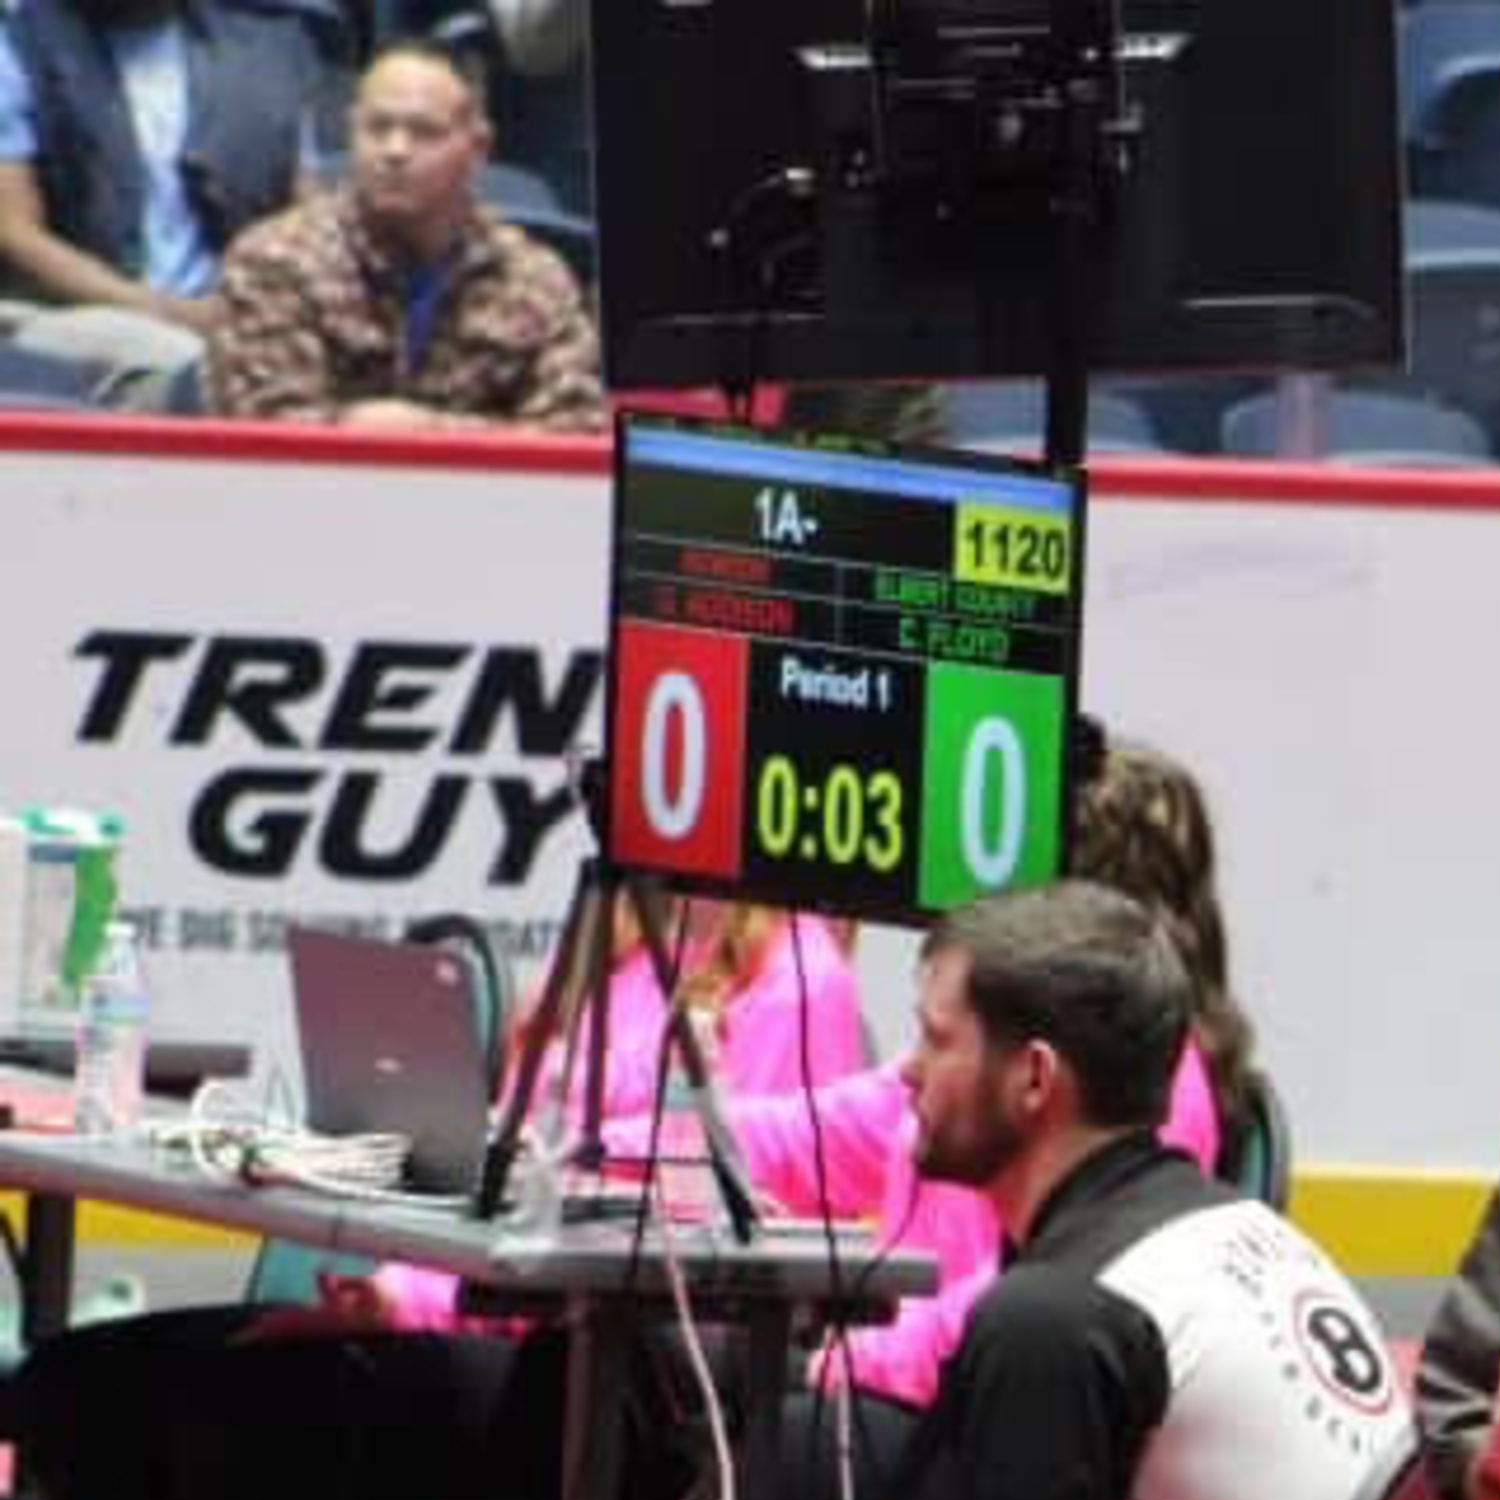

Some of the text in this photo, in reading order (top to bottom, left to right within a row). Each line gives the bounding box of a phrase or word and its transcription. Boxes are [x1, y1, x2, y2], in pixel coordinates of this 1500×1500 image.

[966, 520, 1066, 579] 1120
[781, 655, 890, 711] Period 1
[641, 669, 706, 840] 0
[960, 715, 1028, 888] 0
[757, 754, 903, 874] 0:03
[1307, 1306, 1383, 1395] 8
